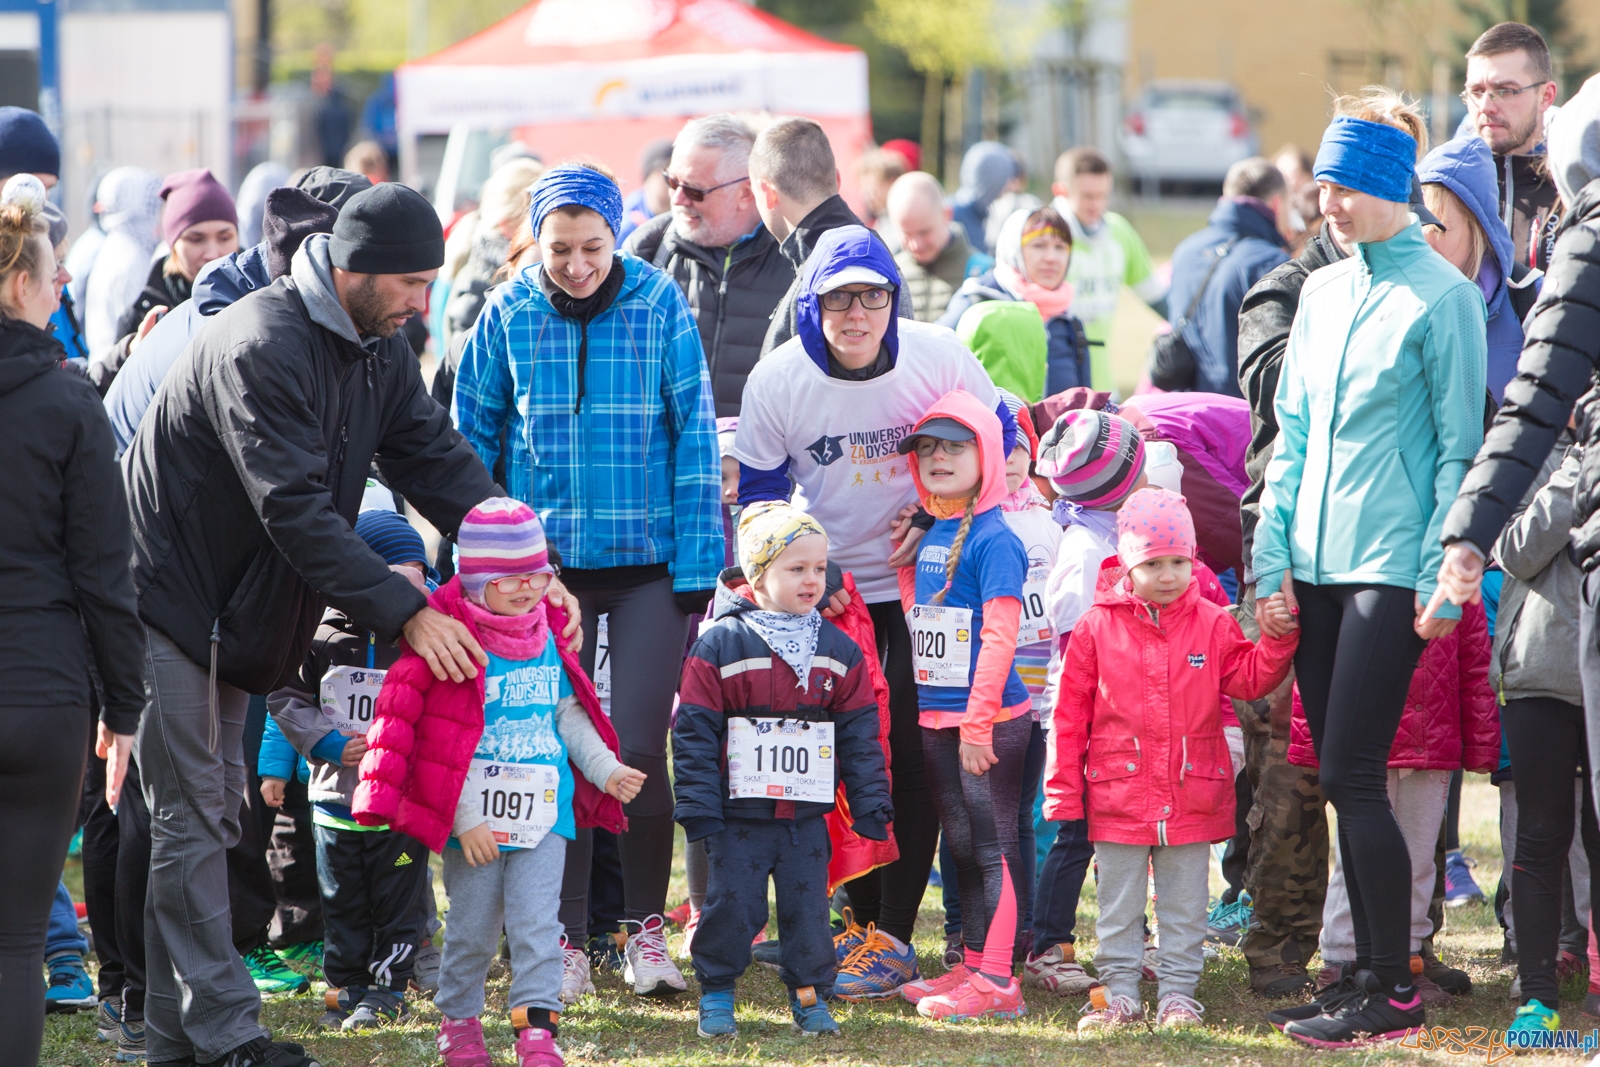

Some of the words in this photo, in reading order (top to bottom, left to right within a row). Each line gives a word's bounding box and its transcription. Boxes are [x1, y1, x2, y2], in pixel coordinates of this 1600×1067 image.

[913, 629, 945, 659] 1020
[337, 721, 352, 730] 5KM
[755, 745, 808, 774] 1100
[796, 777, 816, 786] 10KM
[481, 789, 535, 820] 1097
